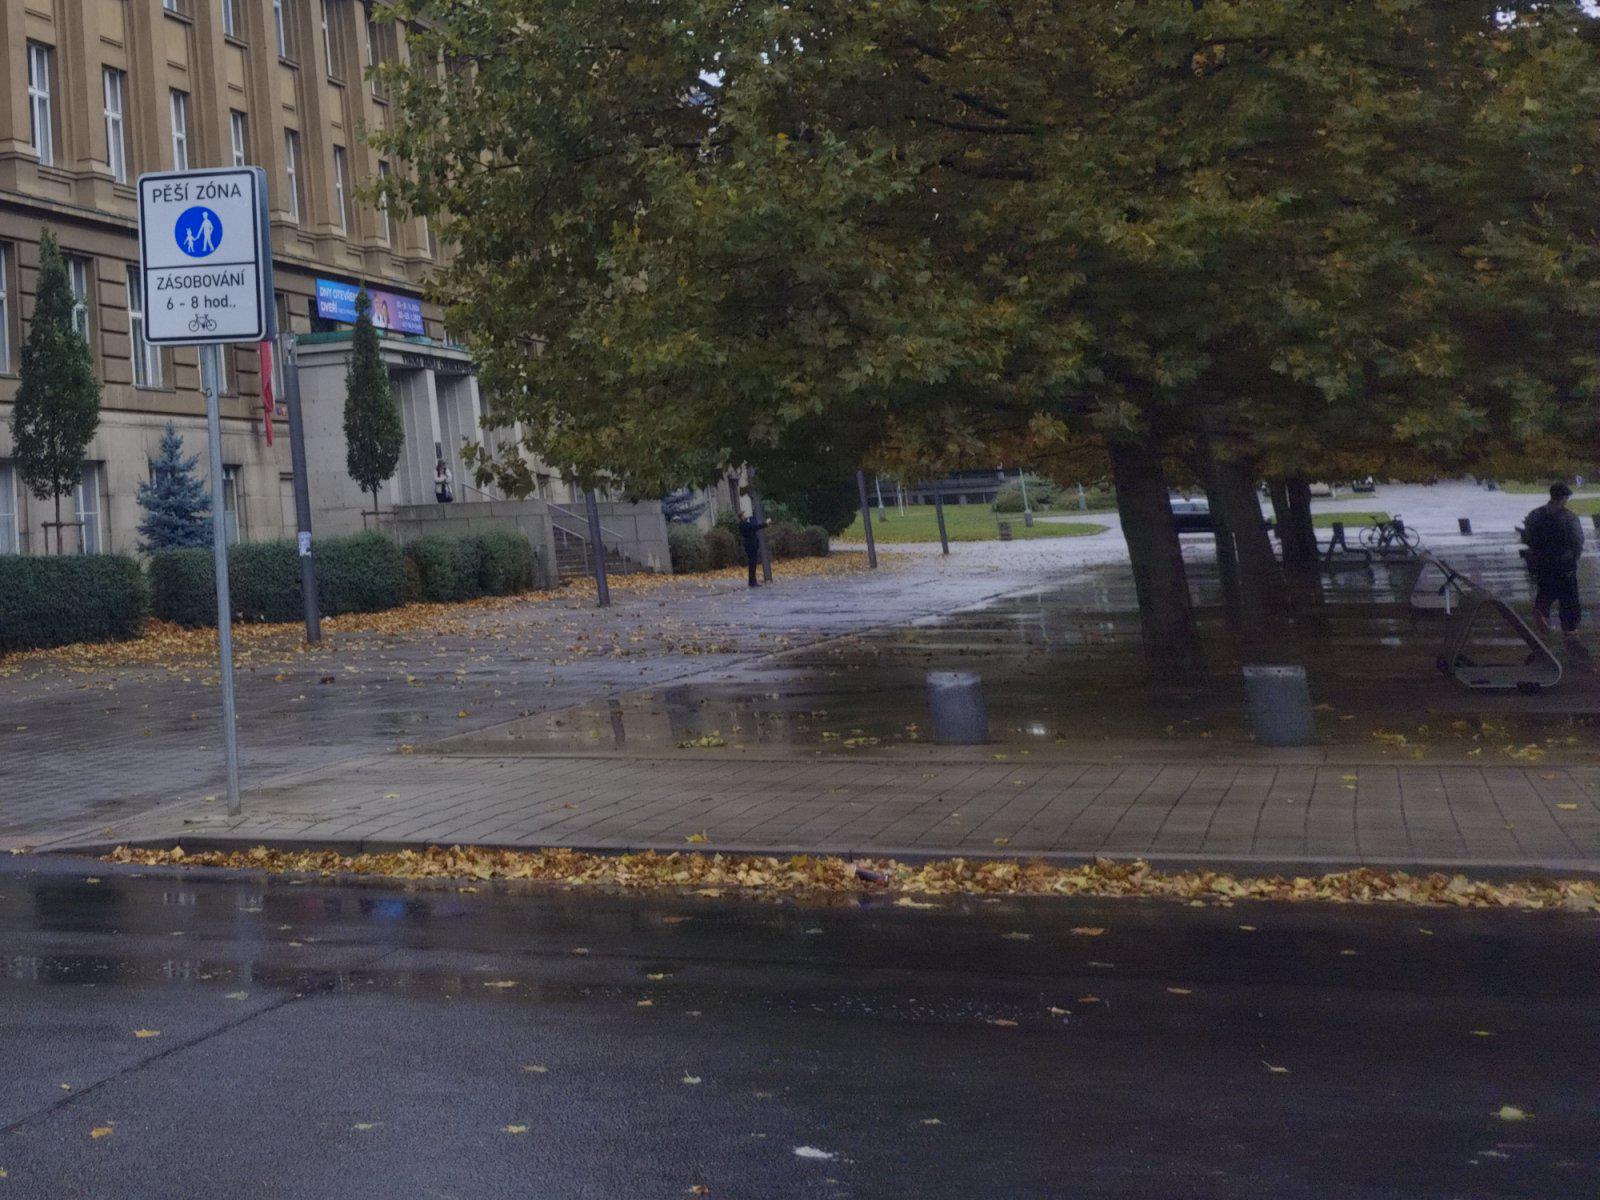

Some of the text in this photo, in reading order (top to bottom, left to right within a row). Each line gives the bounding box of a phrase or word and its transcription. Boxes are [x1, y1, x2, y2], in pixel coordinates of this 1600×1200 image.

[152, 181, 241, 203] PĚŠÍ ZÓNA
[157, 269, 244, 290] ZÁSOBOVÁNÍ
[166, 297, 174, 311] 6
[190, 295, 199, 310] 8
